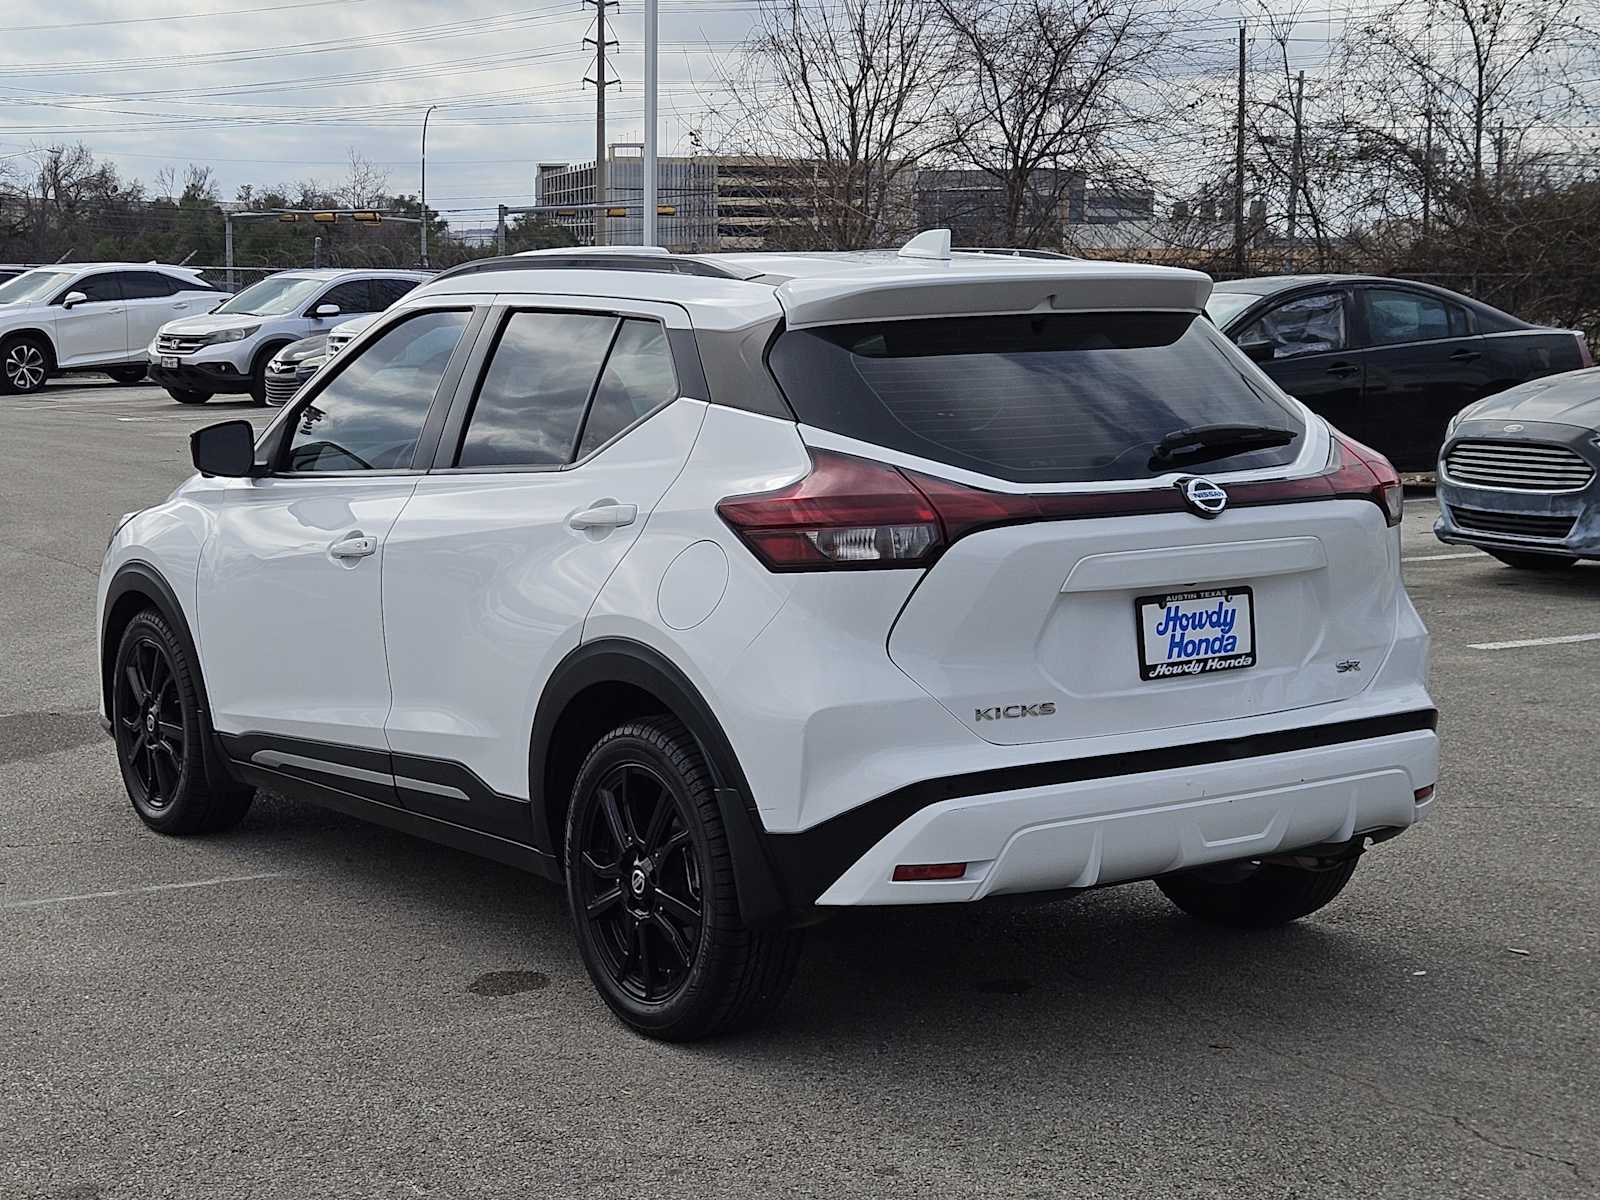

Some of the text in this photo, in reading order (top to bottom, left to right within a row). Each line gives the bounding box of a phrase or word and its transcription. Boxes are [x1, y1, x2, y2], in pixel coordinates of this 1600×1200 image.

[1166, 590, 1228, 602] AUSTIN TEXAS
[1156, 601, 1236, 636] Howdy
[1168, 632, 1237, 660] Honda
[1149, 655, 1253, 677] Howdy Honda
[1335, 660, 1361, 673] SR
[975, 702, 1056, 721] KICKS
